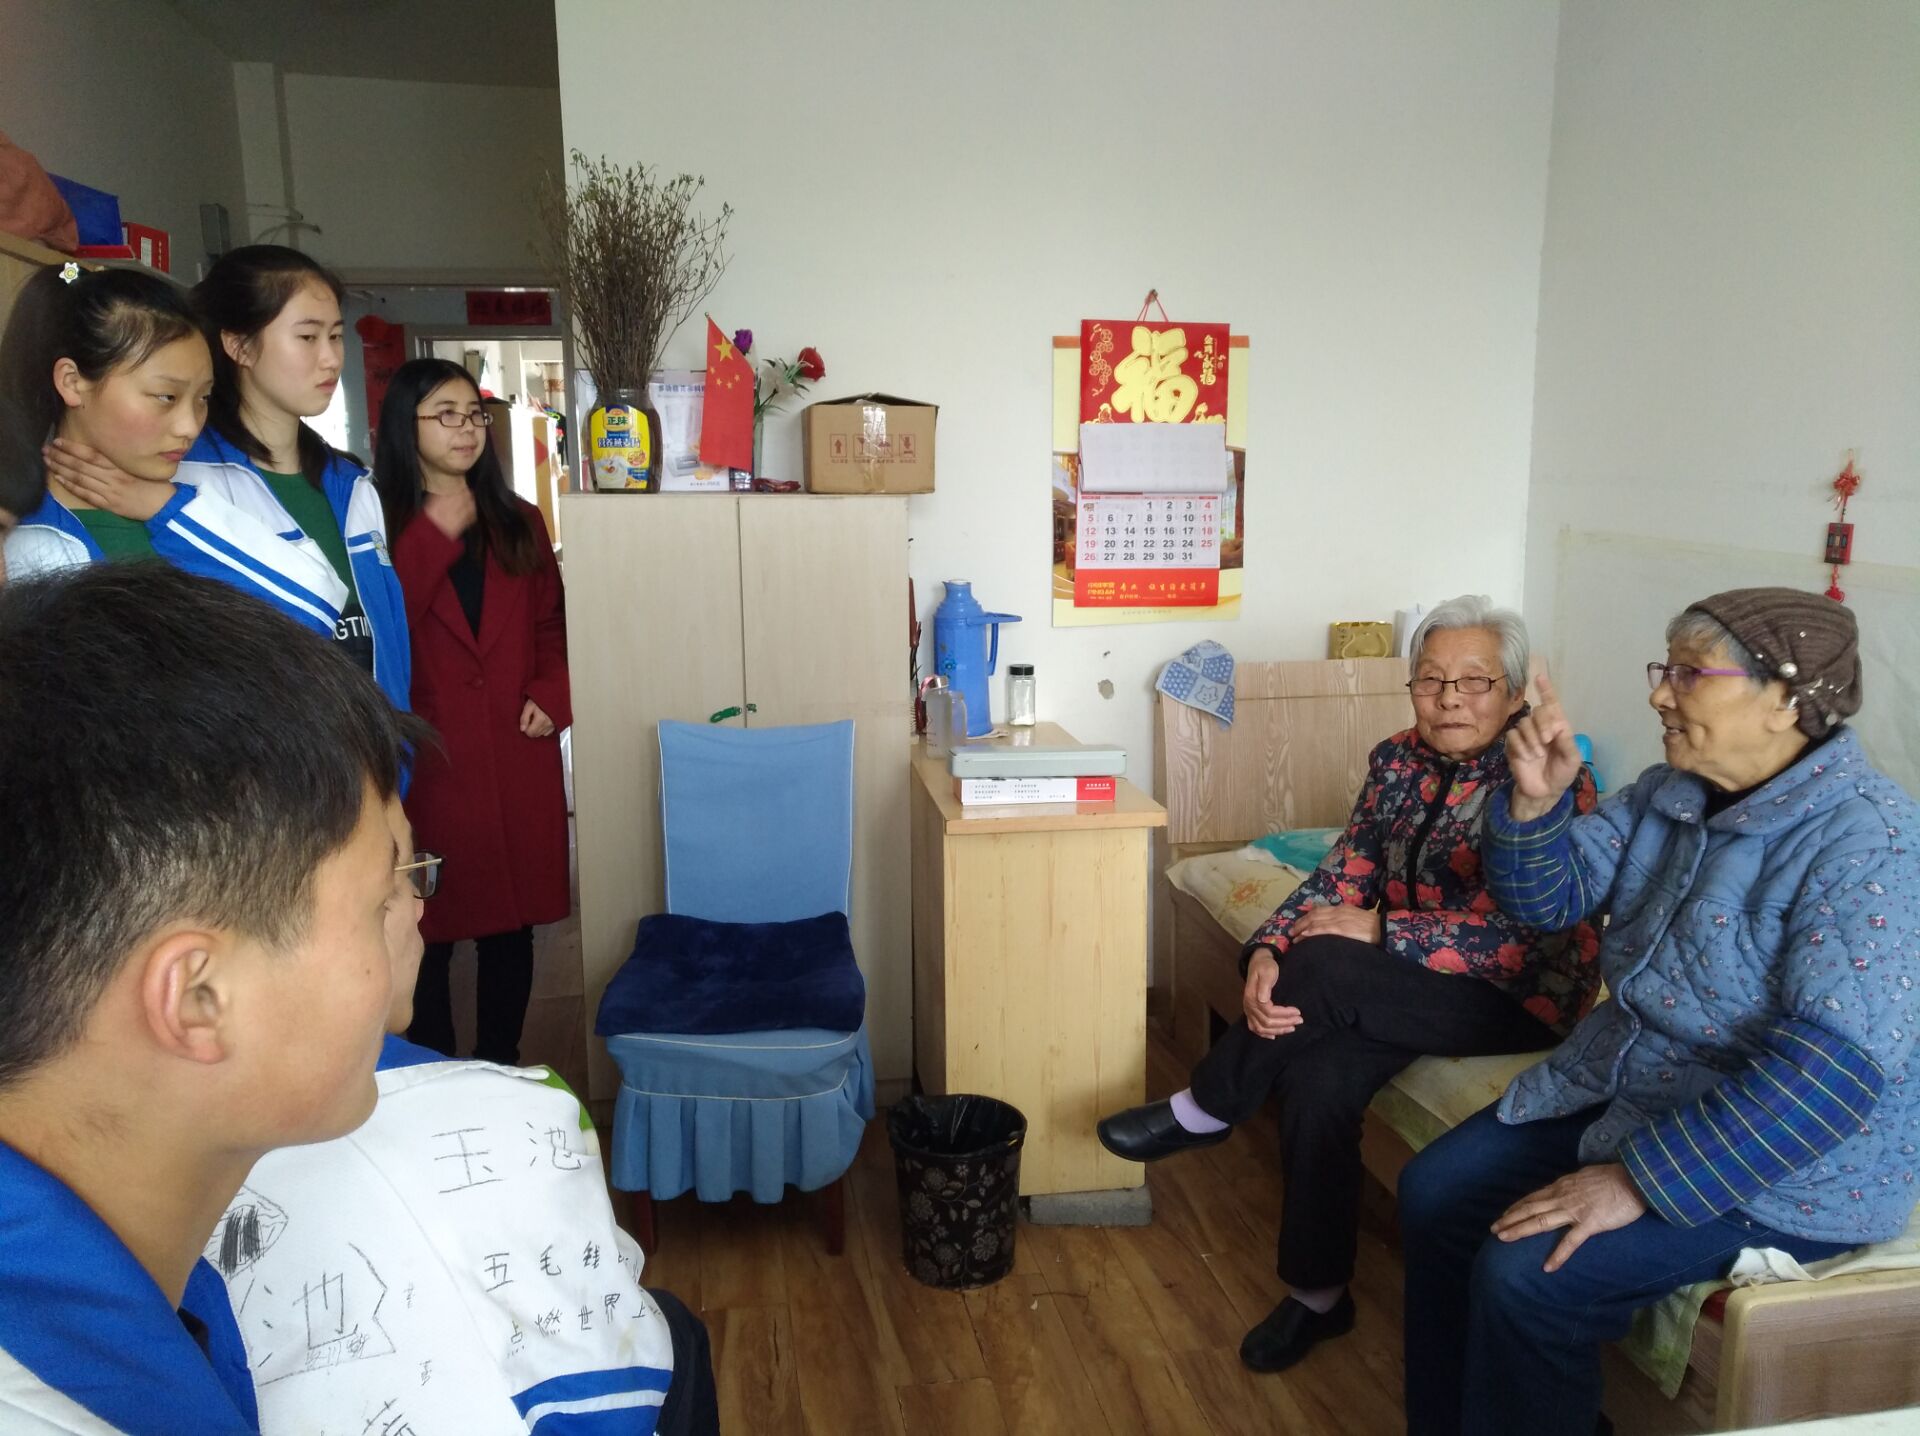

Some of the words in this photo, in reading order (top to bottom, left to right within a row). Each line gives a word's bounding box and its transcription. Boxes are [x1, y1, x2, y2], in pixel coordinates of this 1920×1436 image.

[1110, 324, 1199, 424] 福
[607, 416, 628, 426] 正味
[1146, 501, 1152, 510] 1
[1166, 501, 1173, 510] 2
[1185, 501, 1193, 510] 3
[1204, 501, 1212, 510] 4
[1087, 514, 1095, 523] 5
[1107, 514, 1114, 523] 6
[1127, 514, 1134, 523] 7
[1146, 514, 1153, 524] 8
[1166, 514, 1173, 523] 9
[1183, 514, 1195, 523] 10
[1201, 514, 1213, 522] 11
[1085, 528, 1097, 536] 12
[1104, 527, 1117, 536] 13
[1124, 527, 1136, 535] 14
[1143, 527, 1156, 536] 15
[1163, 527, 1175, 535] 16
[1182, 527, 1194, 535] 17
[1201, 527, 1213, 536] 18
[1084, 540, 1097, 549] 19
[1103, 540, 1116, 549] 20
[1123, 540, 1135, 549] 21
[1143, 540, 1156, 548] 22
[1162, 540, 1175, 548] 23
[1181, 540, 1194, 548] 24
[1200, 540, 1213, 548] 25
[1084, 553, 1096, 561] 26
[1103, 553, 1116, 561] 27
[1123, 553, 1136, 561] 28
[1142, 553, 1155, 561] 29
[1162, 553, 1175, 561] 30
[1181, 552, 1193, 561] 31
